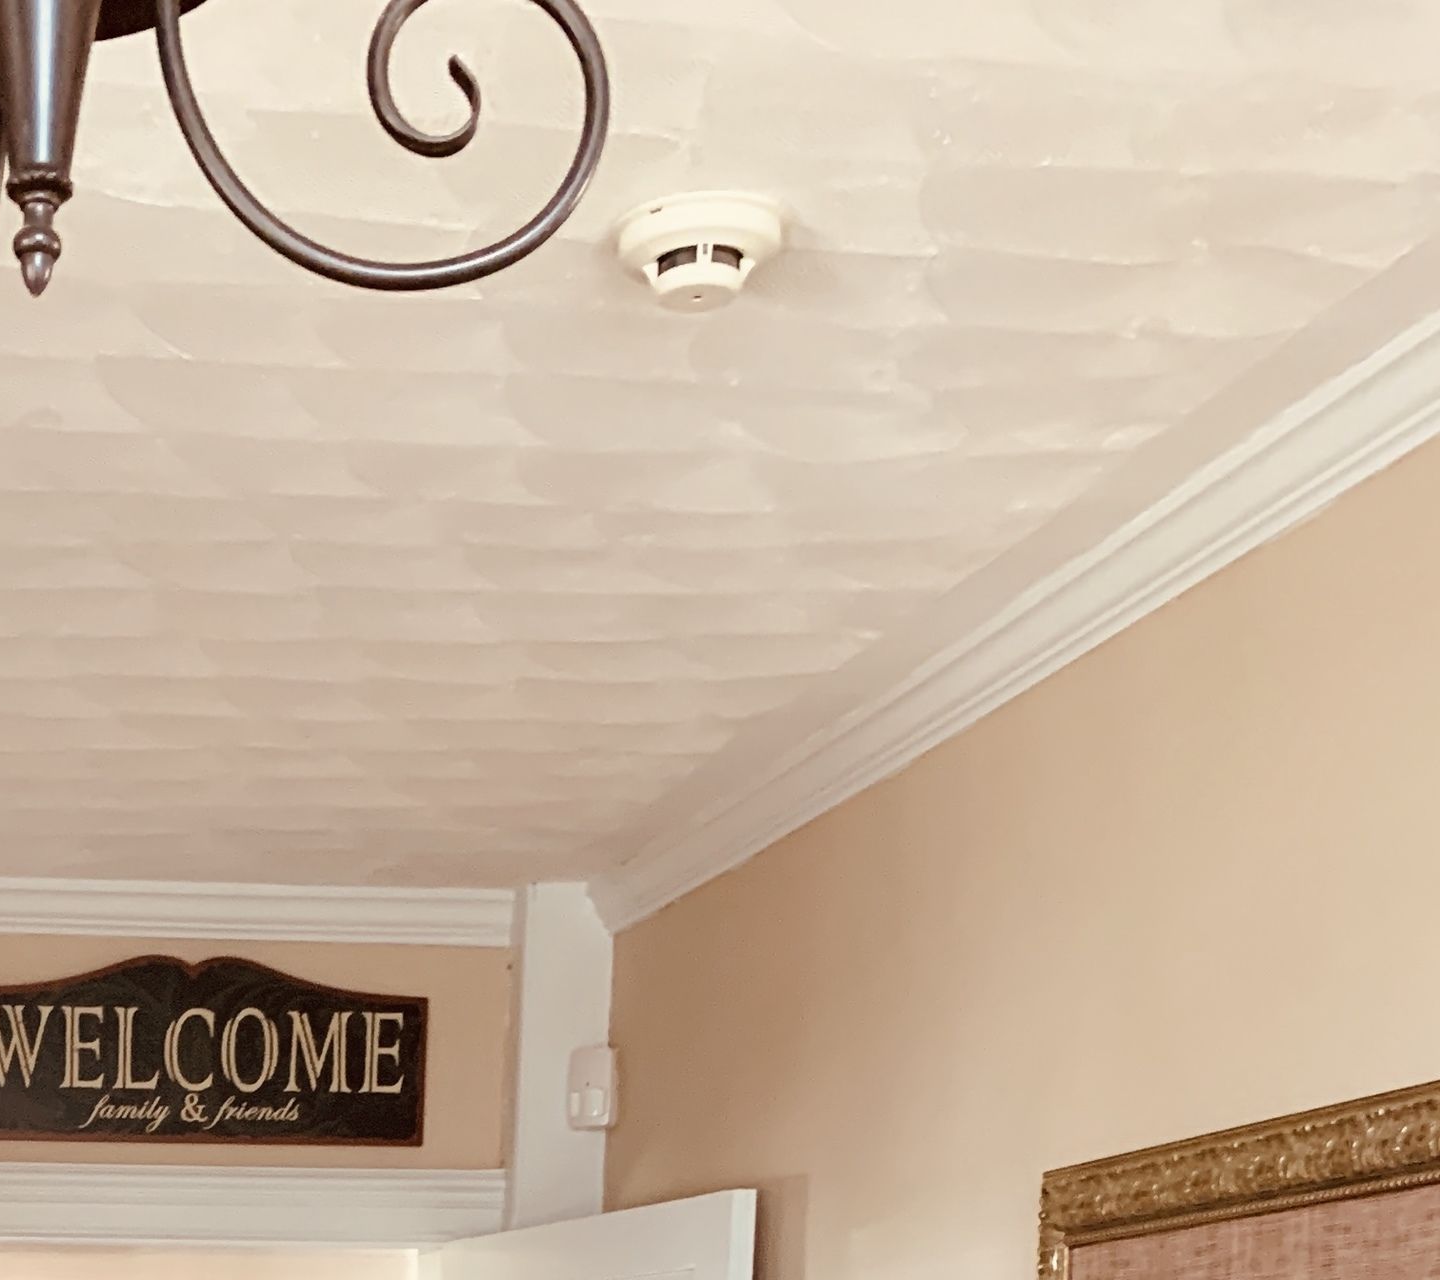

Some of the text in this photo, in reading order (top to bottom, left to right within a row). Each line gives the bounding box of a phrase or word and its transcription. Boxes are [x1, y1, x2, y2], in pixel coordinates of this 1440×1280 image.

[79, 1093, 300, 1132] family & friends
